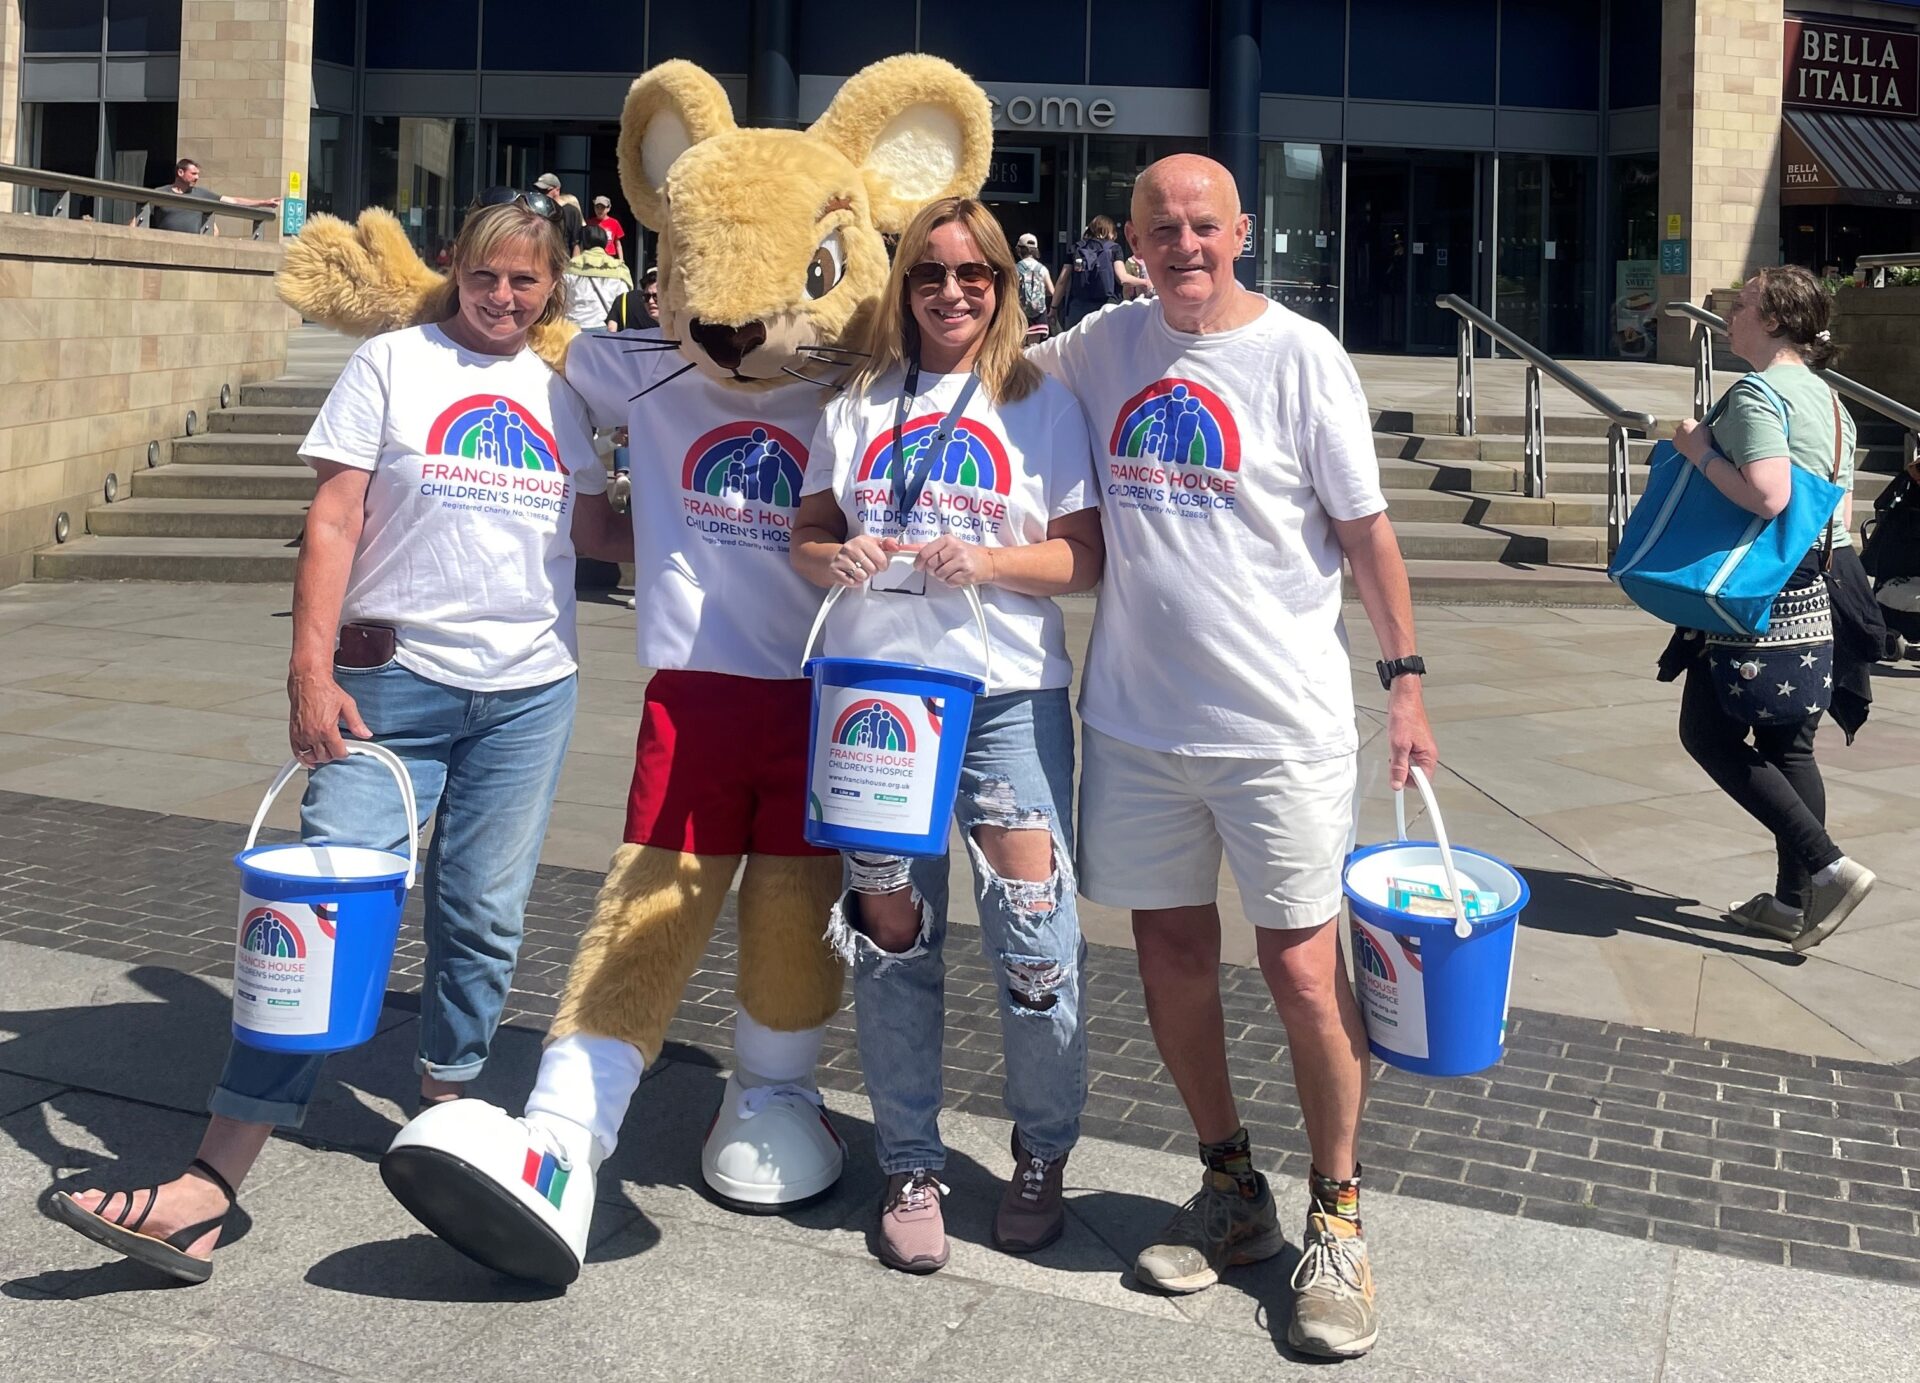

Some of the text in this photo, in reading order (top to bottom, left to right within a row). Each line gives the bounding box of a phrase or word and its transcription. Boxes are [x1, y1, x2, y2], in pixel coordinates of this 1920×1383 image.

[1802, 29, 1900, 70] BELLA
[1798, 67, 1903, 107] ITALIA
[1786, 173, 1819, 184] ITALIA
[1787, 164, 1819, 174] BELLA
[421, 463, 571, 500] FRANCIS HOUSE
[1110, 463, 1237, 495] FRANCIS HOUSE
[420, 483, 568, 515] CHILDREN'S HOSPICE
[854, 488, 1008, 521] FRAIS HOUSE
[1168, 491, 1236, 510] HOSPICE
[484, 505, 511, 517] Charity
[682, 497, 795, 530] FRANCIS HOU
[685, 515, 758, 541] CHILDREN'S
[911, 527, 938, 538] Charity
[939, 514, 1001, 535] HOSPICE
[829, 748, 915, 768] FRANCIS HOUSE
[828, 759, 914, 778] CHILDREN'S HOSPICE
[828, 774, 910, 791] www.francishouse.org.uk
[267, 960, 305, 974] HOUSE
[268, 971, 305, 983] HOSPICE
[1366, 977, 1398, 997] HOUSE
